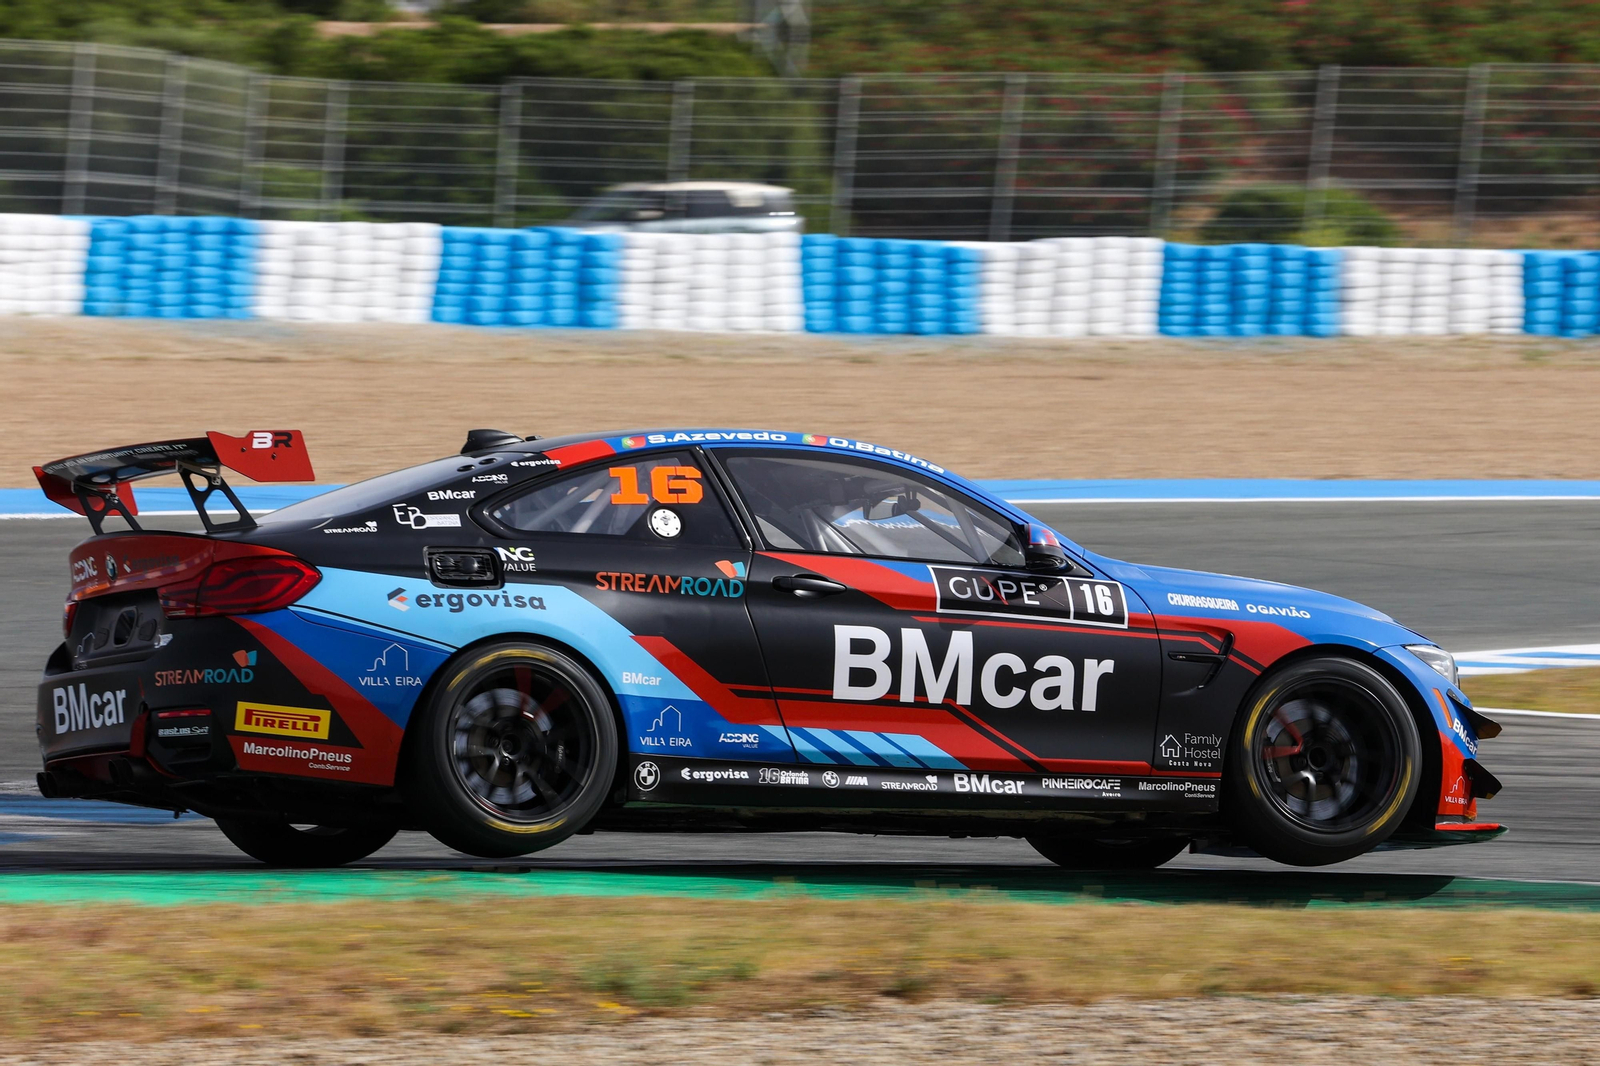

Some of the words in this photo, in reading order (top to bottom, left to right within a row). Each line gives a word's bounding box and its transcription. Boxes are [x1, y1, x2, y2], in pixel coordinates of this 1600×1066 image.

[252, 432, 293, 449] BR
[647, 432, 787, 443] S.Azevedo
[520, 459, 562, 467] ergovisa
[829, 437, 945, 474] O.Batina
[608, 465, 704, 505] 16
[427, 489, 477, 501] BMcar
[324, 526, 378, 534] STREAMROAD
[594, 571, 744, 598] STREAMROAD
[415, 590, 547, 613] ergovisa
[1080, 583, 1114, 616] 16
[1167, 592, 1240, 611] CHURRASQUEIRA
[832, 624, 1115, 712] BMcar
[154, 668, 255, 687] STREAMROAD
[358, 676, 391, 686] VILLA
[395, 676, 423, 687] EIRA
[622, 672, 662, 686] BMcar
[53, 683, 126, 735] BMcar
[243, 708, 322, 733] PIRELLI
[640, 736, 666, 746] VILLA
[669, 737, 693, 747] EIRA
[718, 733, 760, 744] ADDING
[1184, 733, 1222, 747] Family
[1453, 718, 1478, 755] BMcar
[243, 742, 353, 763] MarcolinoPneus
[1184, 747, 1221, 759] Hostel
[692, 768, 750, 782] ergovisa
[758, 768, 780, 784] 16
[881, 781, 938, 791] STREAMROAD
[954, 773, 1026, 795] BMcar
[1138, 782, 1216, 792] MarcolinoPneus
